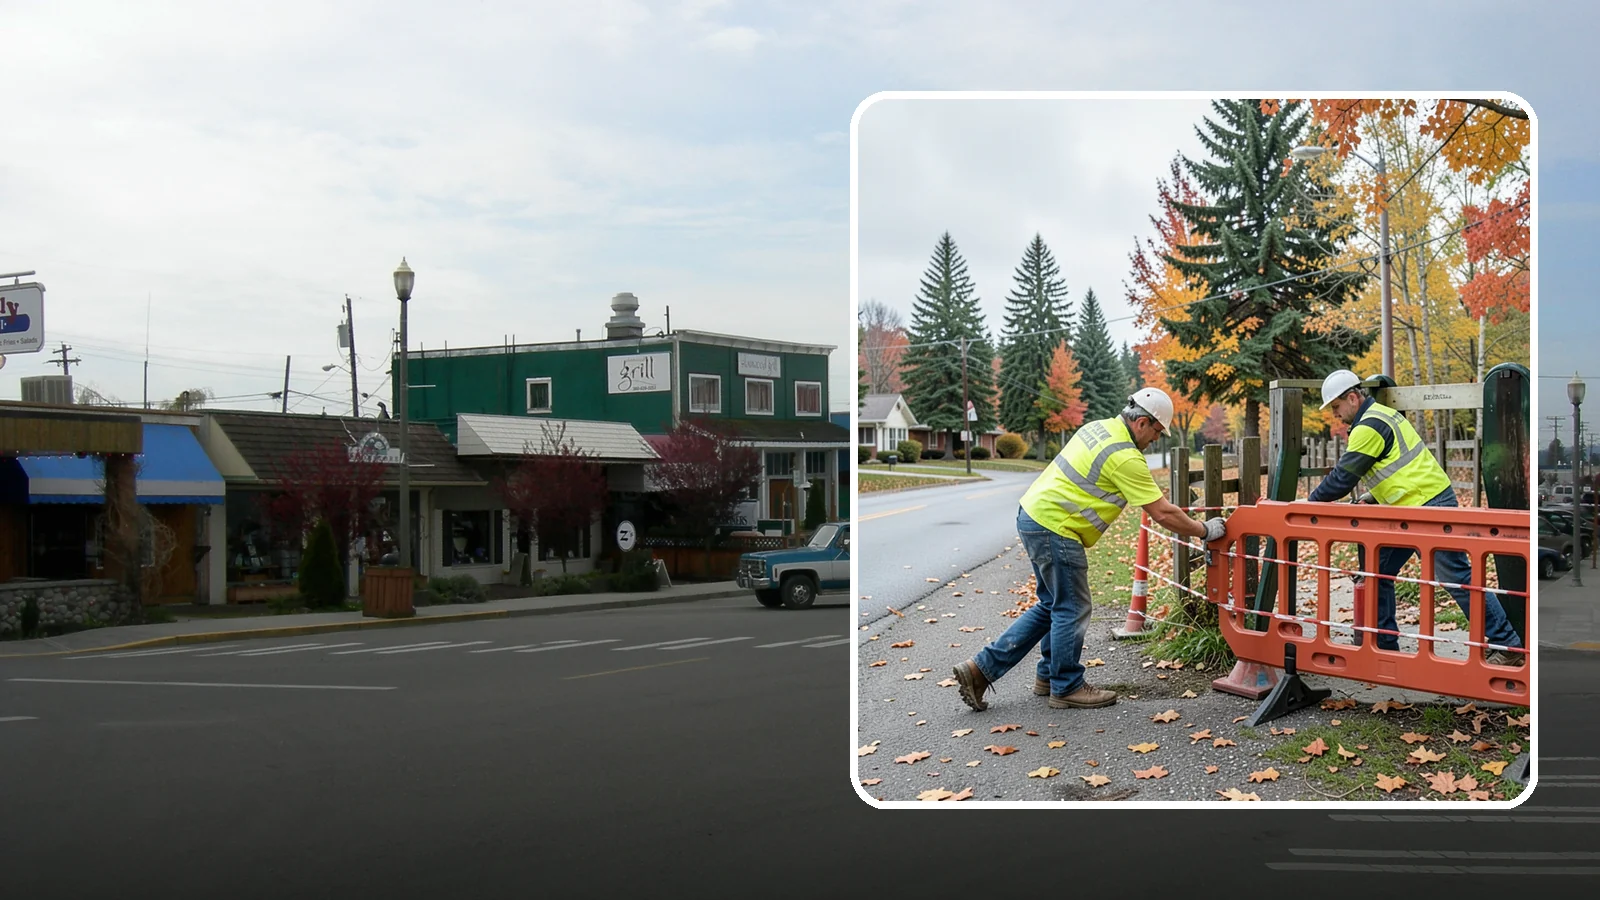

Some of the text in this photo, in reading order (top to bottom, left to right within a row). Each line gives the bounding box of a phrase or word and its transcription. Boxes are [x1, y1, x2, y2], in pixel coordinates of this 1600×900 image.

[3, 337, 38, 346] Fries Salads
[618, 356, 655, 391] grill
